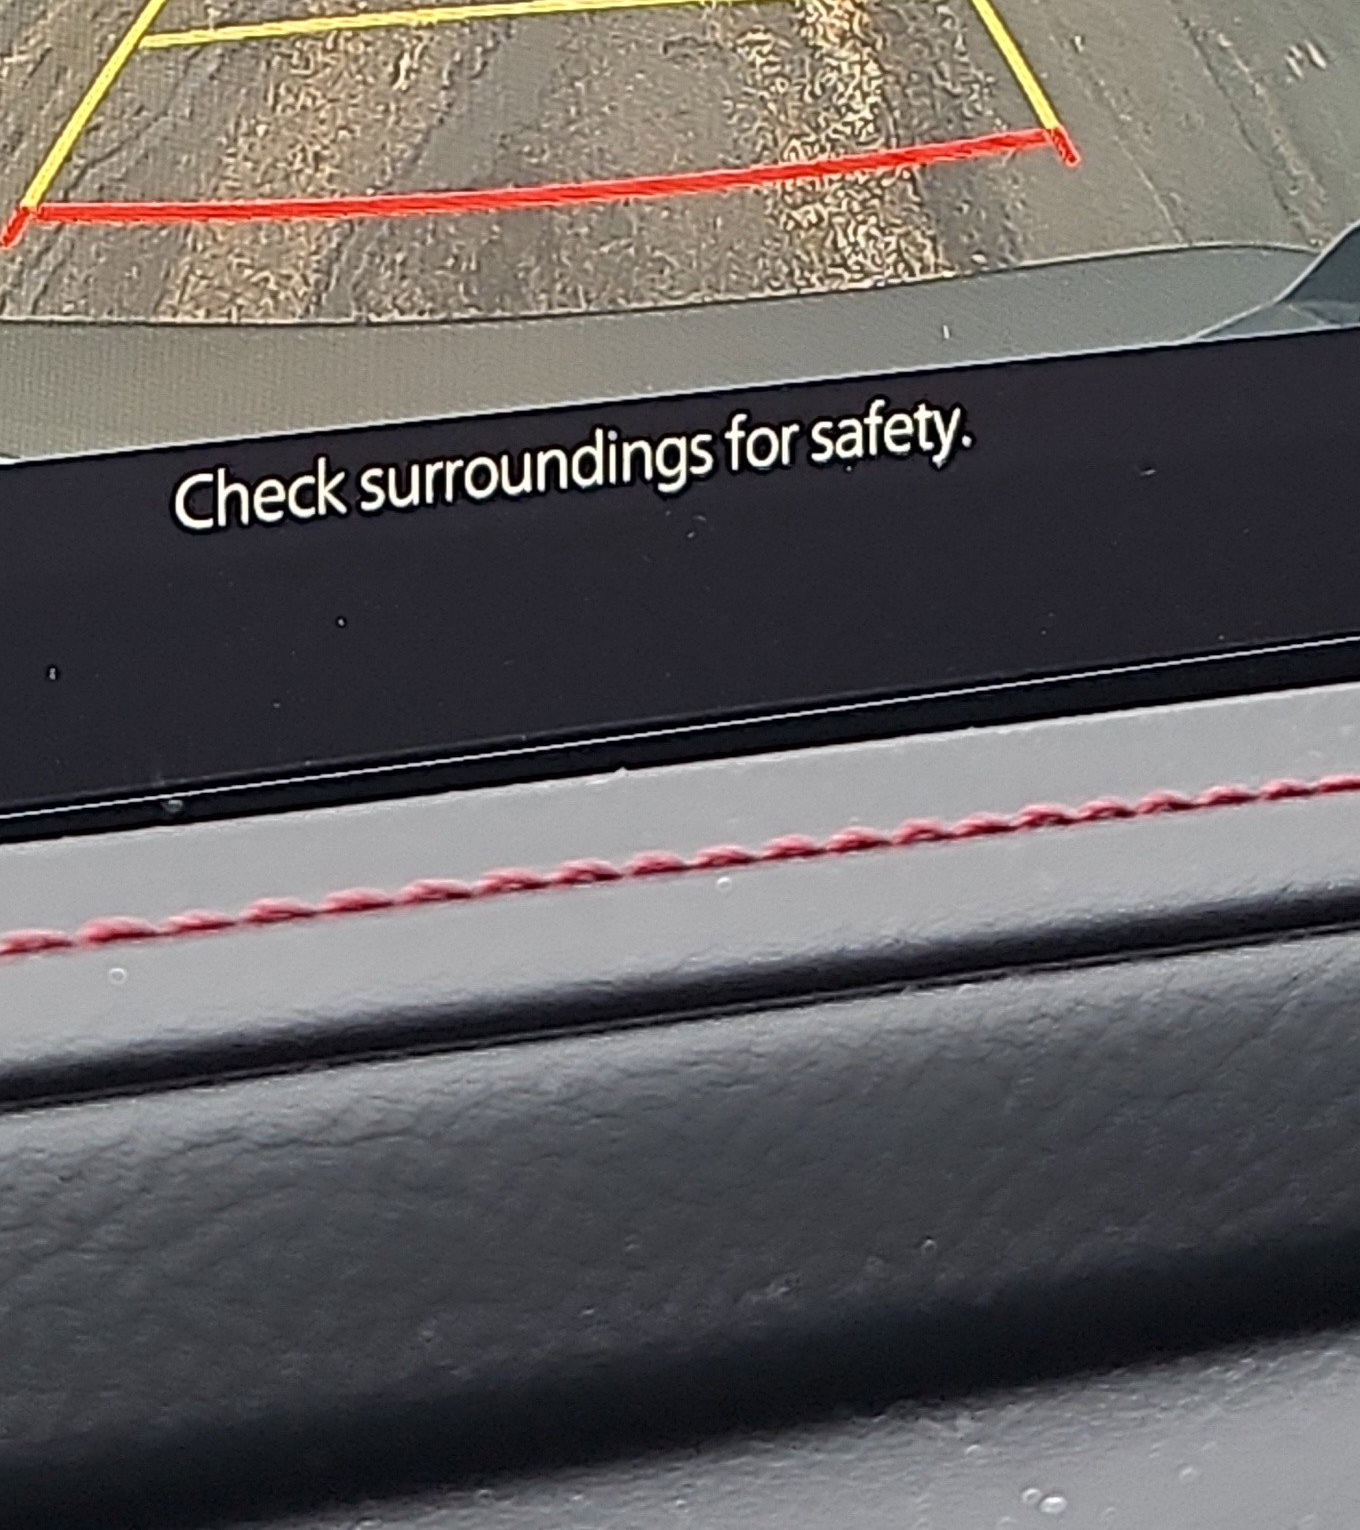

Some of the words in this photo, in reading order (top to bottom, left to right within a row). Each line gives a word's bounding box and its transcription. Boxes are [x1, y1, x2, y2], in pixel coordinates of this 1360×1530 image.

[174, 456, 348, 530] Check
[359, 426, 714, 512] surroundings
[723, 412, 801, 471] for
[810, 398, 974, 468] safety.
